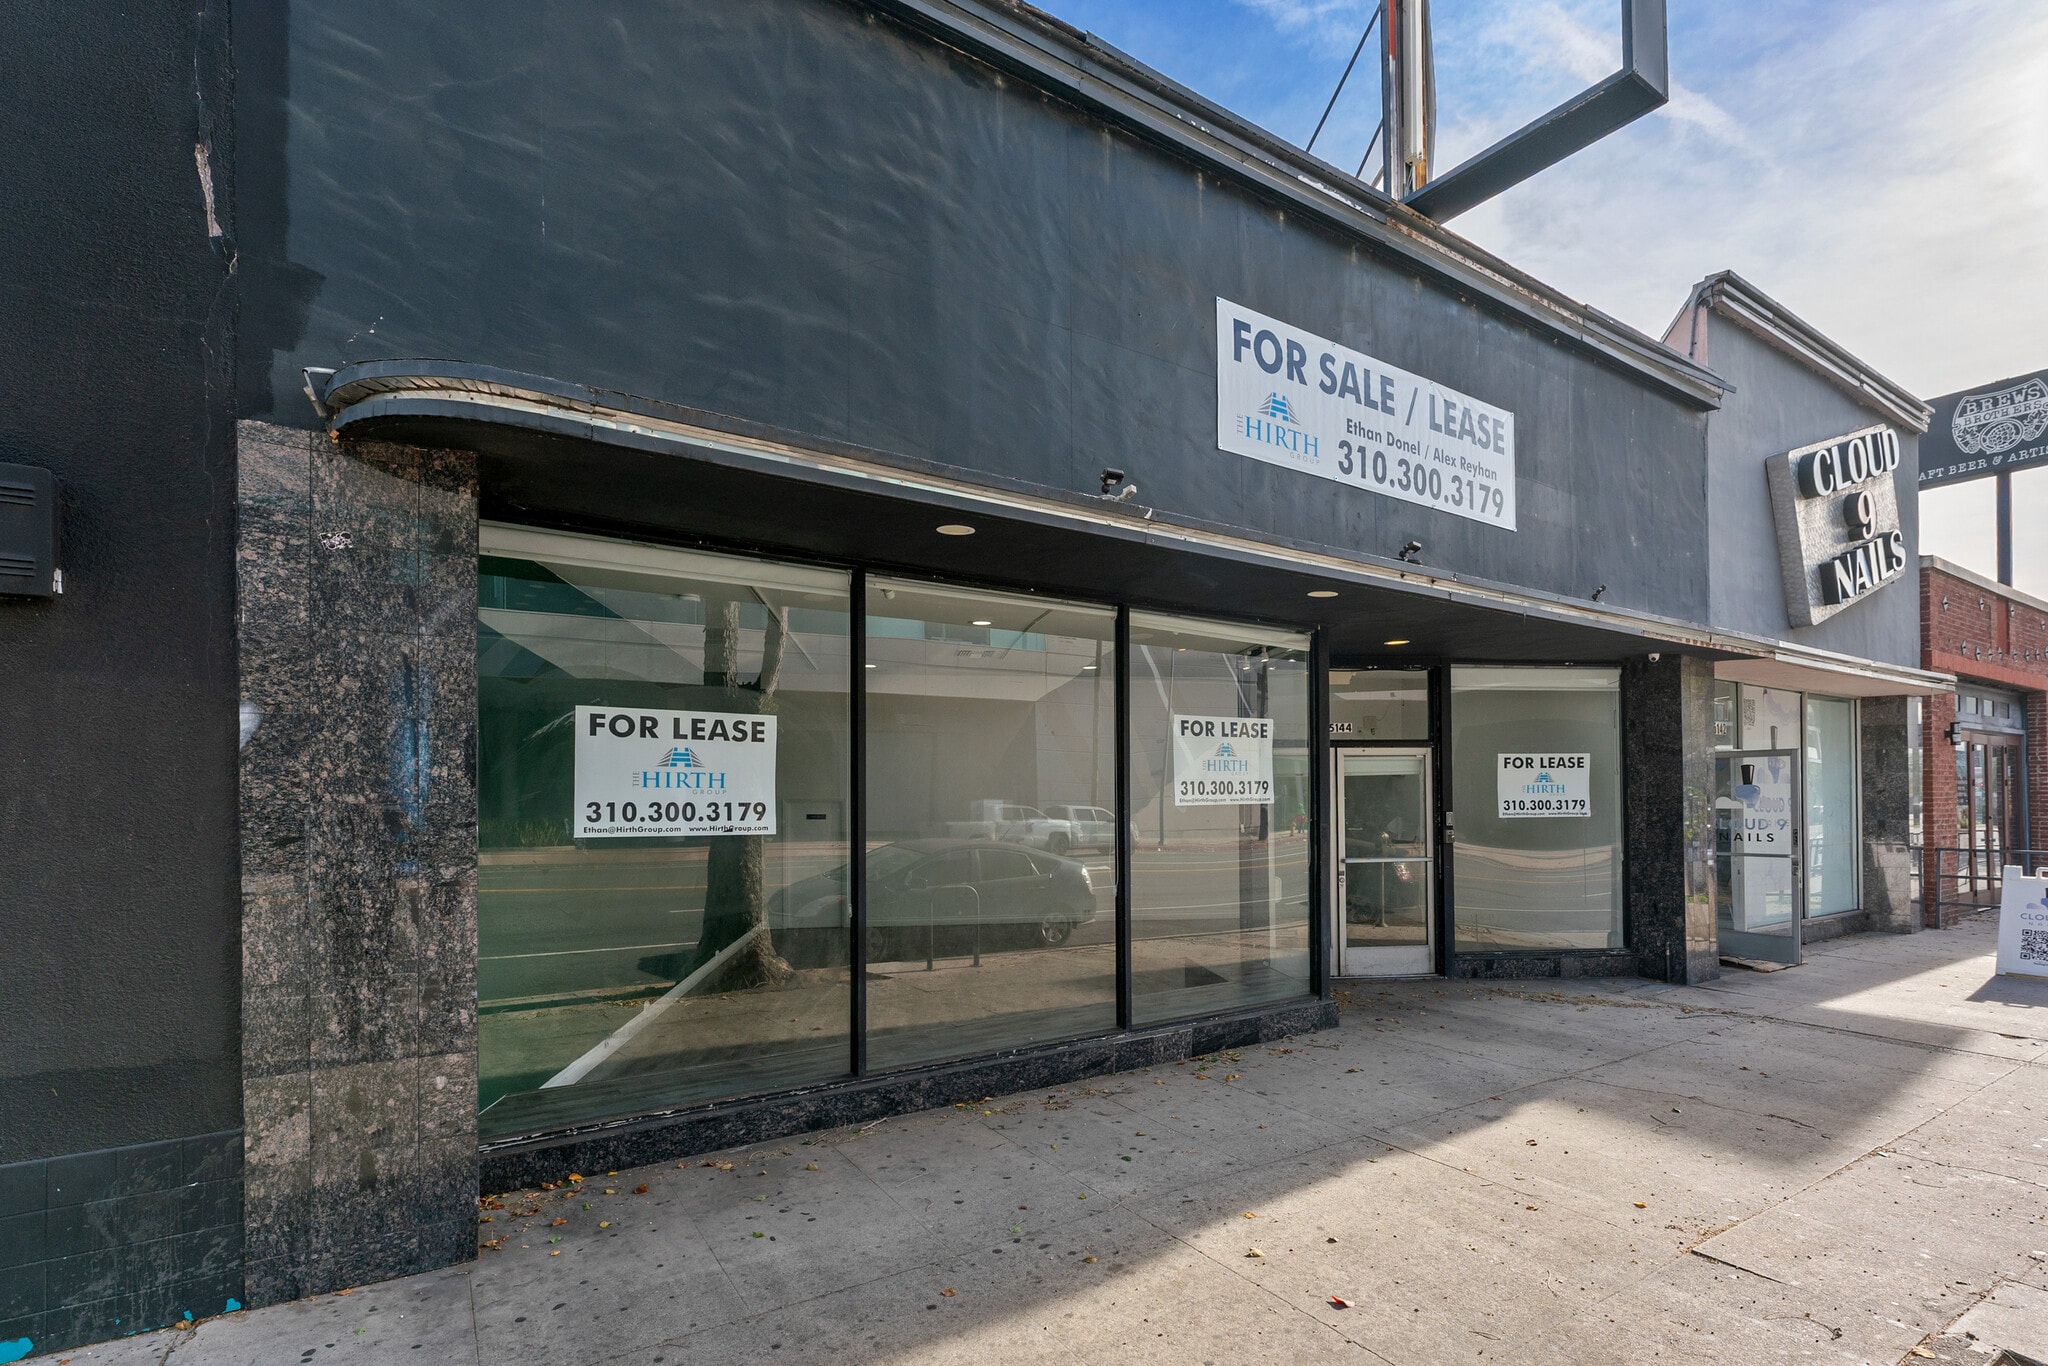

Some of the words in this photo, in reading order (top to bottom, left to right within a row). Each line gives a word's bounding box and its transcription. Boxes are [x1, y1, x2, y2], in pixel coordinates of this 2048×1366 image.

[1233, 318, 1307, 386] FOR
[1319, 352, 1395, 416] SALE
[1405, 387, 1419, 426] /
[1429, 394, 1505, 456] LEASE
[1963, 386, 2041, 416] BREWS
[1236, 412, 1244, 435] THE
[1963, 400, 2042, 427] BROTHERS
[1245, 415, 1319, 458] HIRTH
[1290, 452, 1321, 465] GROUP
[1346, 418, 1383, 444] Ethan
[1387, 431, 1421, 456] Donel
[1424, 444, 1430, 460] /
[1433, 447, 1457, 468] Alex
[1460, 457, 1497, 482] Reyhan
[1812, 428, 1900, 496] CLOUD
[1919, 467, 1945, 481] AFT
[1948, 458, 1987, 475] BEER
[1992, 455, 2003, 466] &
[1338, 440, 1504, 518] 310.300.3179
[1857, 490, 1877, 540] 9
[1832, 529, 1907, 604] NAILS
[589, 713, 659, 739] FOR
[673, 717, 765, 743] LEASE
[1180, 719, 1215, 737] FOR
[1221, 721, 1268, 738] LEASE
[1329, 723, 1352, 733] 5144
[1207, 759, 1248, 772] HIRTH
[1504, 757, 1534, 769] FOR
[1540, 757, 1584, 769] LEASE
[632, 771, 640, 787] THE
[642, 771, 726, 789] HIRTH
[1181, 781, 1269, 796] 310.300.3179
[1526, 784, 1565, 794] HIRTH
[586, 801, 766, 823] 310.300.3179
[1503, 800, 1586, 811] 310.300.3179
[583, 825, 682, 834] Ethan@HirthGroup.com
[1718, 818, 1769, 831] LOUD
[1719, 832, 1775, 842] NAILS
